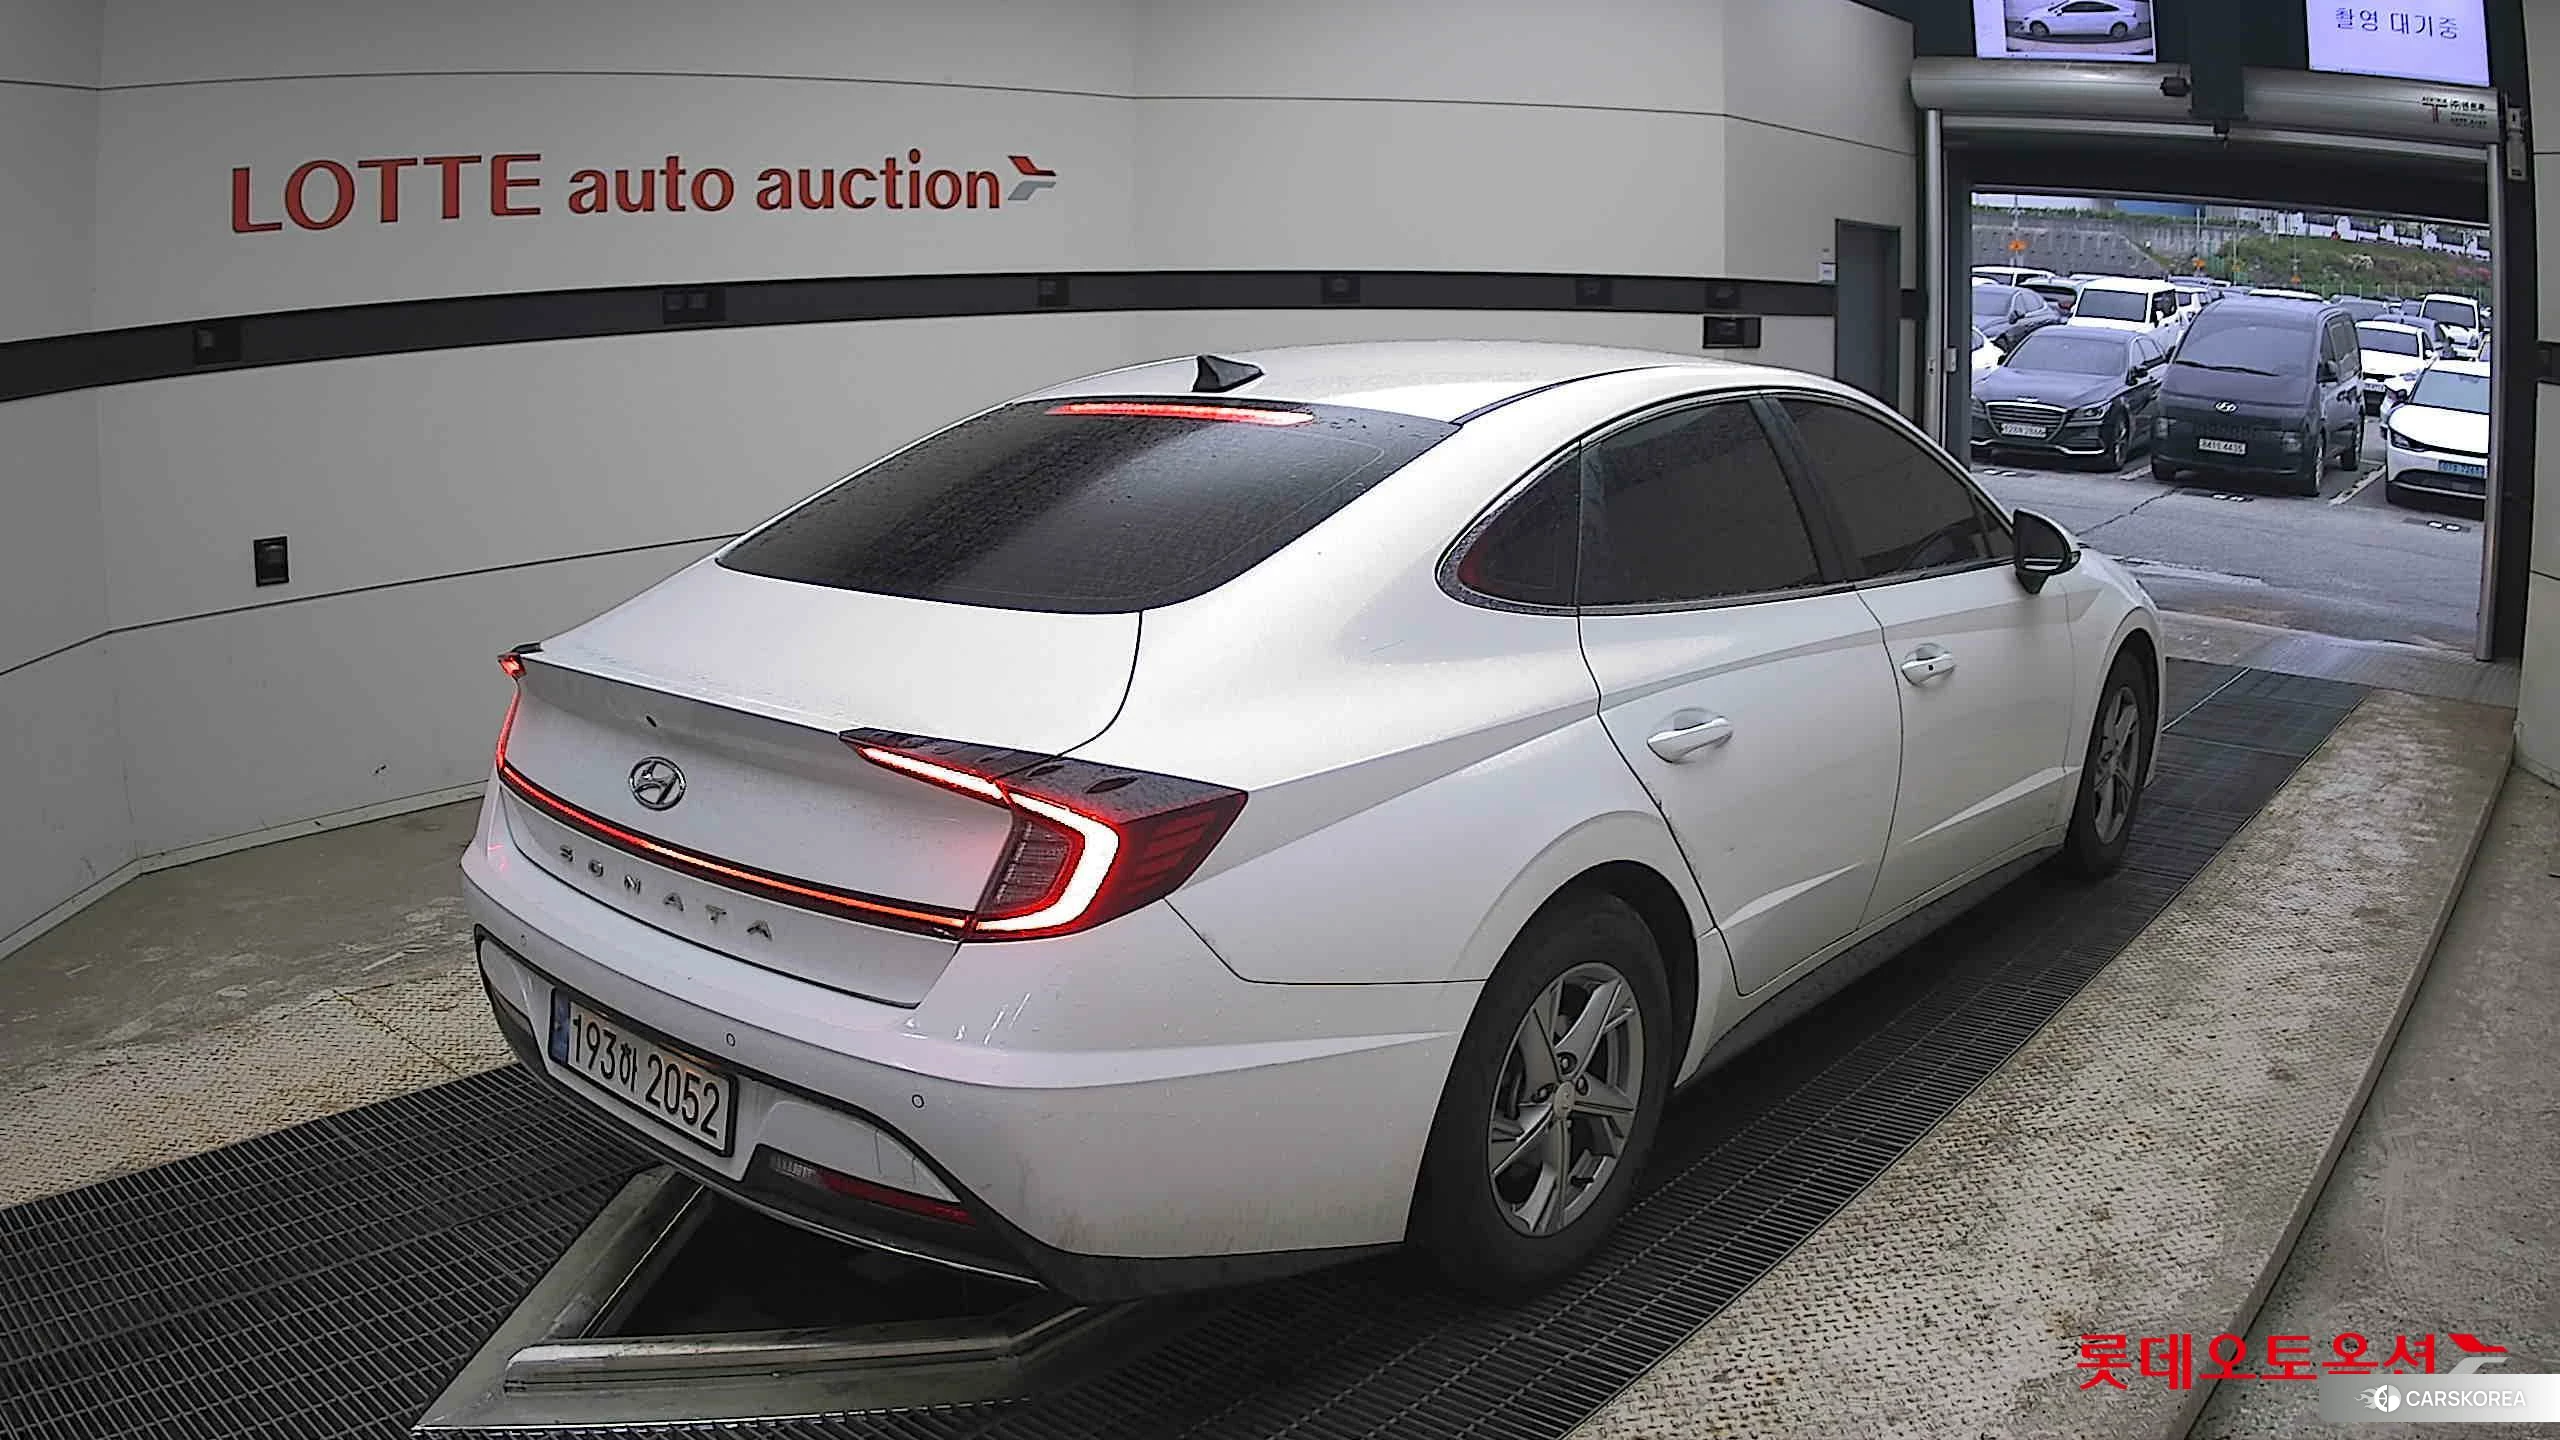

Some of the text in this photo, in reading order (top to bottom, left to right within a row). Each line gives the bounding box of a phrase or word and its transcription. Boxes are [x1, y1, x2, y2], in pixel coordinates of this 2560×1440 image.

[2335, 7, 2458, 40] 촬영 대기중
[232, 147, 1001, 233] LOTTE auto auction
[558, 845, 773, 941] SONATA
[571, 1012, 721, 1139] 193하 2052
